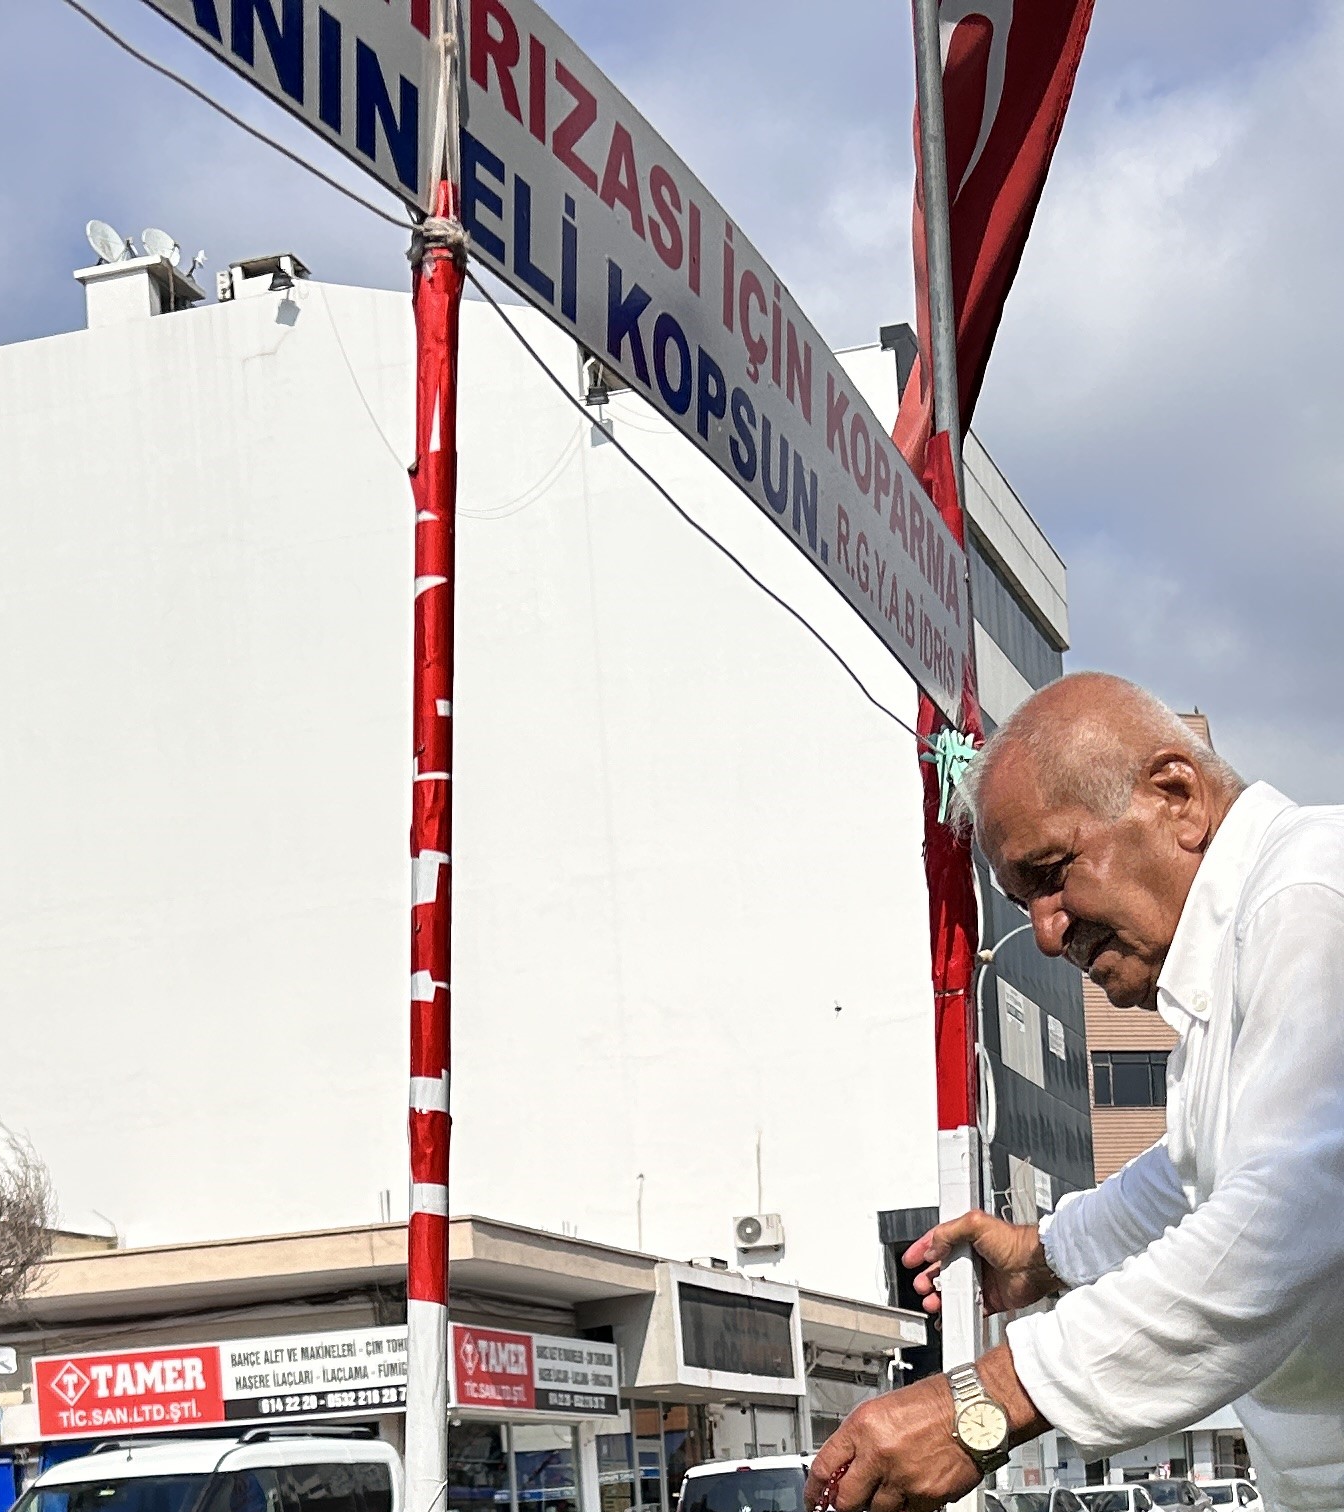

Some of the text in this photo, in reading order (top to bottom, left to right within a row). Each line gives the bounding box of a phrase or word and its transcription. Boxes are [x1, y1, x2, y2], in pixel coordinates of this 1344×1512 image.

[192, 0, 828, 566] NIN ELİ KOPSUN.
[469, 0, 960, 628] RIZASI İÇİN KOPARMA
[919, 594, 955, 700] İDRİS
[230, 1350, 262, 1371] BAHÇE
[264, 1348, 284, 1365] ALET
[287, 1347, 298, 1362] VE
[300, 1338, 357, 1362] MAKİNELERİ
[365, 1338, 384, 1357] ÇİM
[477, 1339, 528, 1376] TAMER
[90, 1356, 207, 1399] TAMER
[235, 1374, 270, 1391] HAŞERE
[272, 1368, 314, 1391] İLAÇLARI
[322, 1364, 369, 1385] İLAÇLAMA
